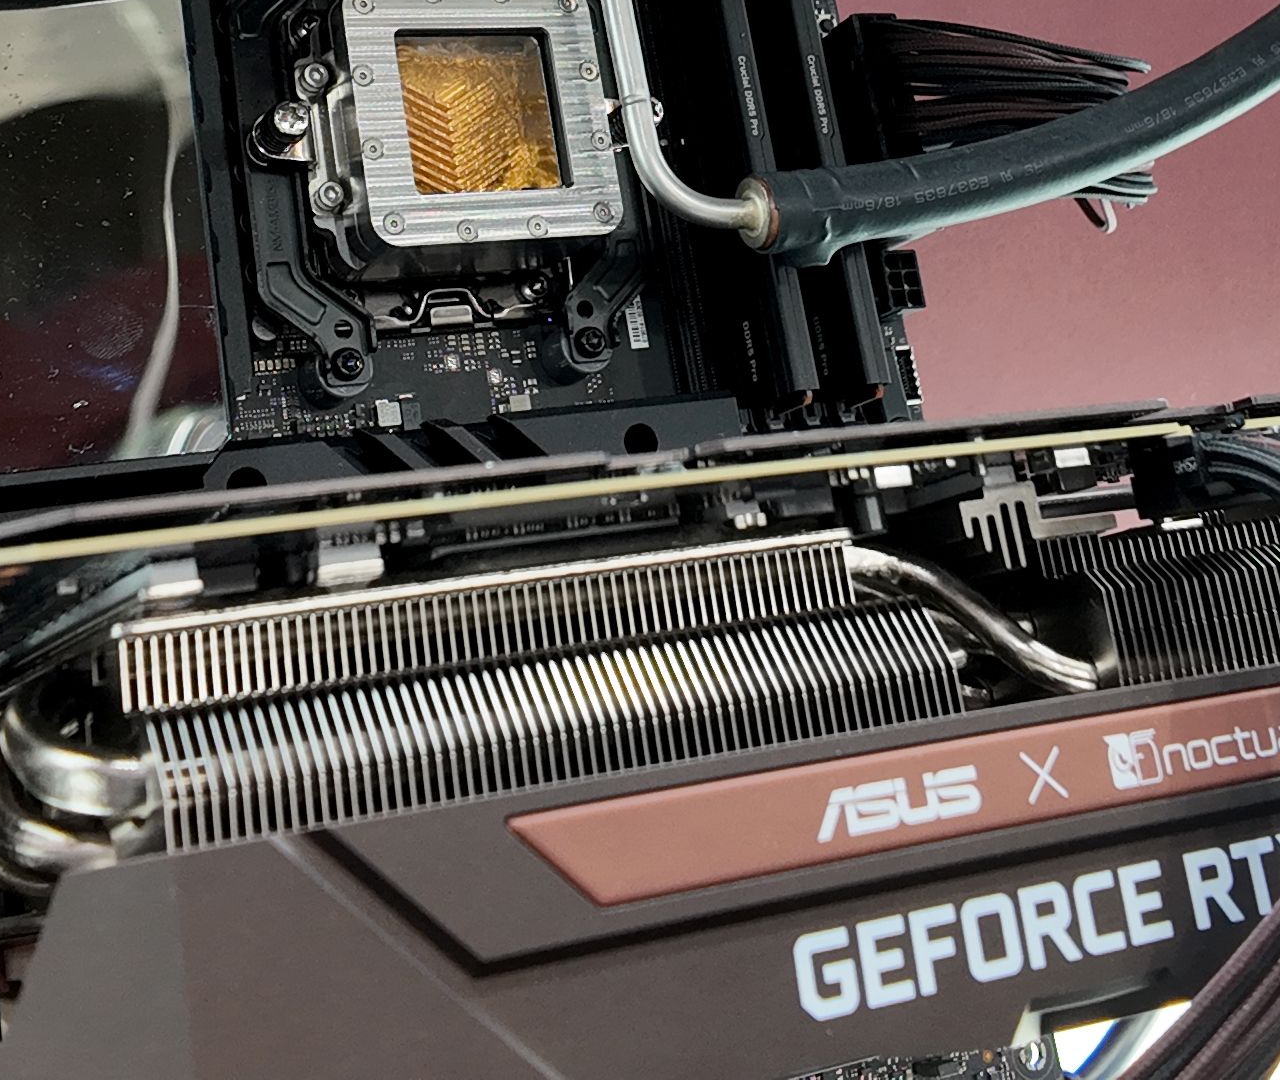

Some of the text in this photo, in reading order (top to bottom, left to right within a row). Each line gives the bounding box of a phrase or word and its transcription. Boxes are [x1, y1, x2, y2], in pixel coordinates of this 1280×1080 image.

[738, 55, 759, 136] Crucial DDR5 Pro
[807, 54, 828, 134] Crucial DDR5 Pro
[1183, 66, 1247, 109] E337635
[913, 174, 990, 204] E337635
[742, 320, 758, 382] DDR5 Pro
[817, 764, 982, 844] ASUS
[792, 860, 1174, 1022] GEFORCE
